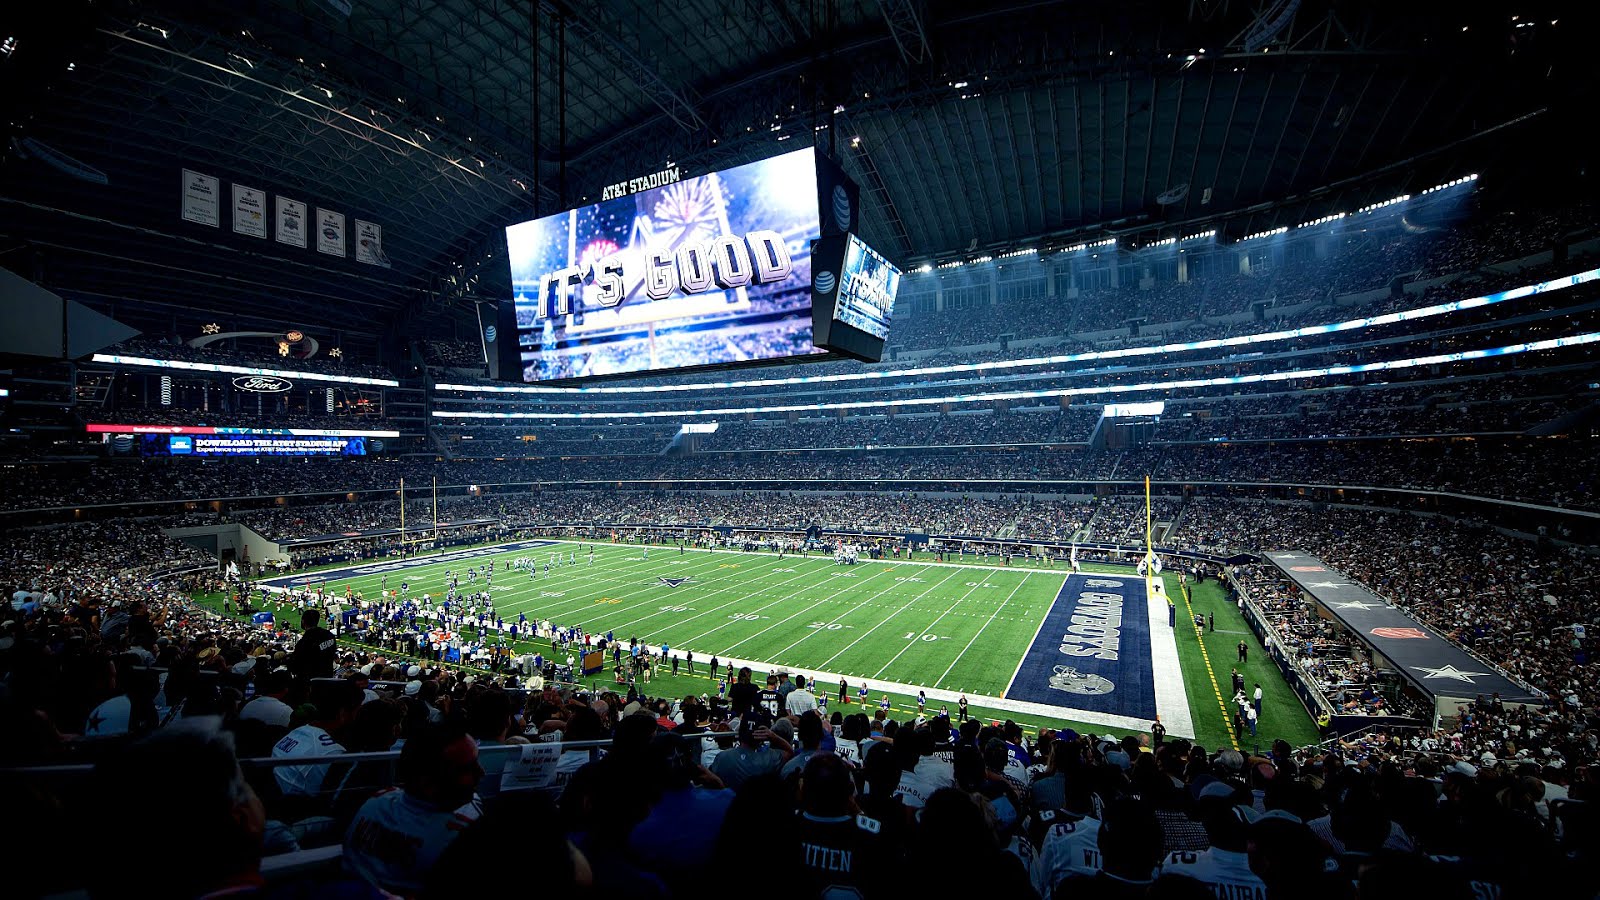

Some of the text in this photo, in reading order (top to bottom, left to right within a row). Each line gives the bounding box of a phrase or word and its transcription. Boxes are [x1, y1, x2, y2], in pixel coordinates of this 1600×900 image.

[602, 166, 680, 201] AT&T STADIUM
[537, 256, 626, 320] IT'S
[645, 230, 794, 301] GOOD
[244, 377, 281, 390] Ford
[196, 439, 253, 448] DOWNLOAD
[253, 440, 272, 448] THE
[295, 440, 332, 448] STADIUM
[333, 441, 348, 449] APP
[807, 622, 842, 630] 20
[1059, 592, 1123, 660] COWBOYS
[902, 632, 938, 642] 10
